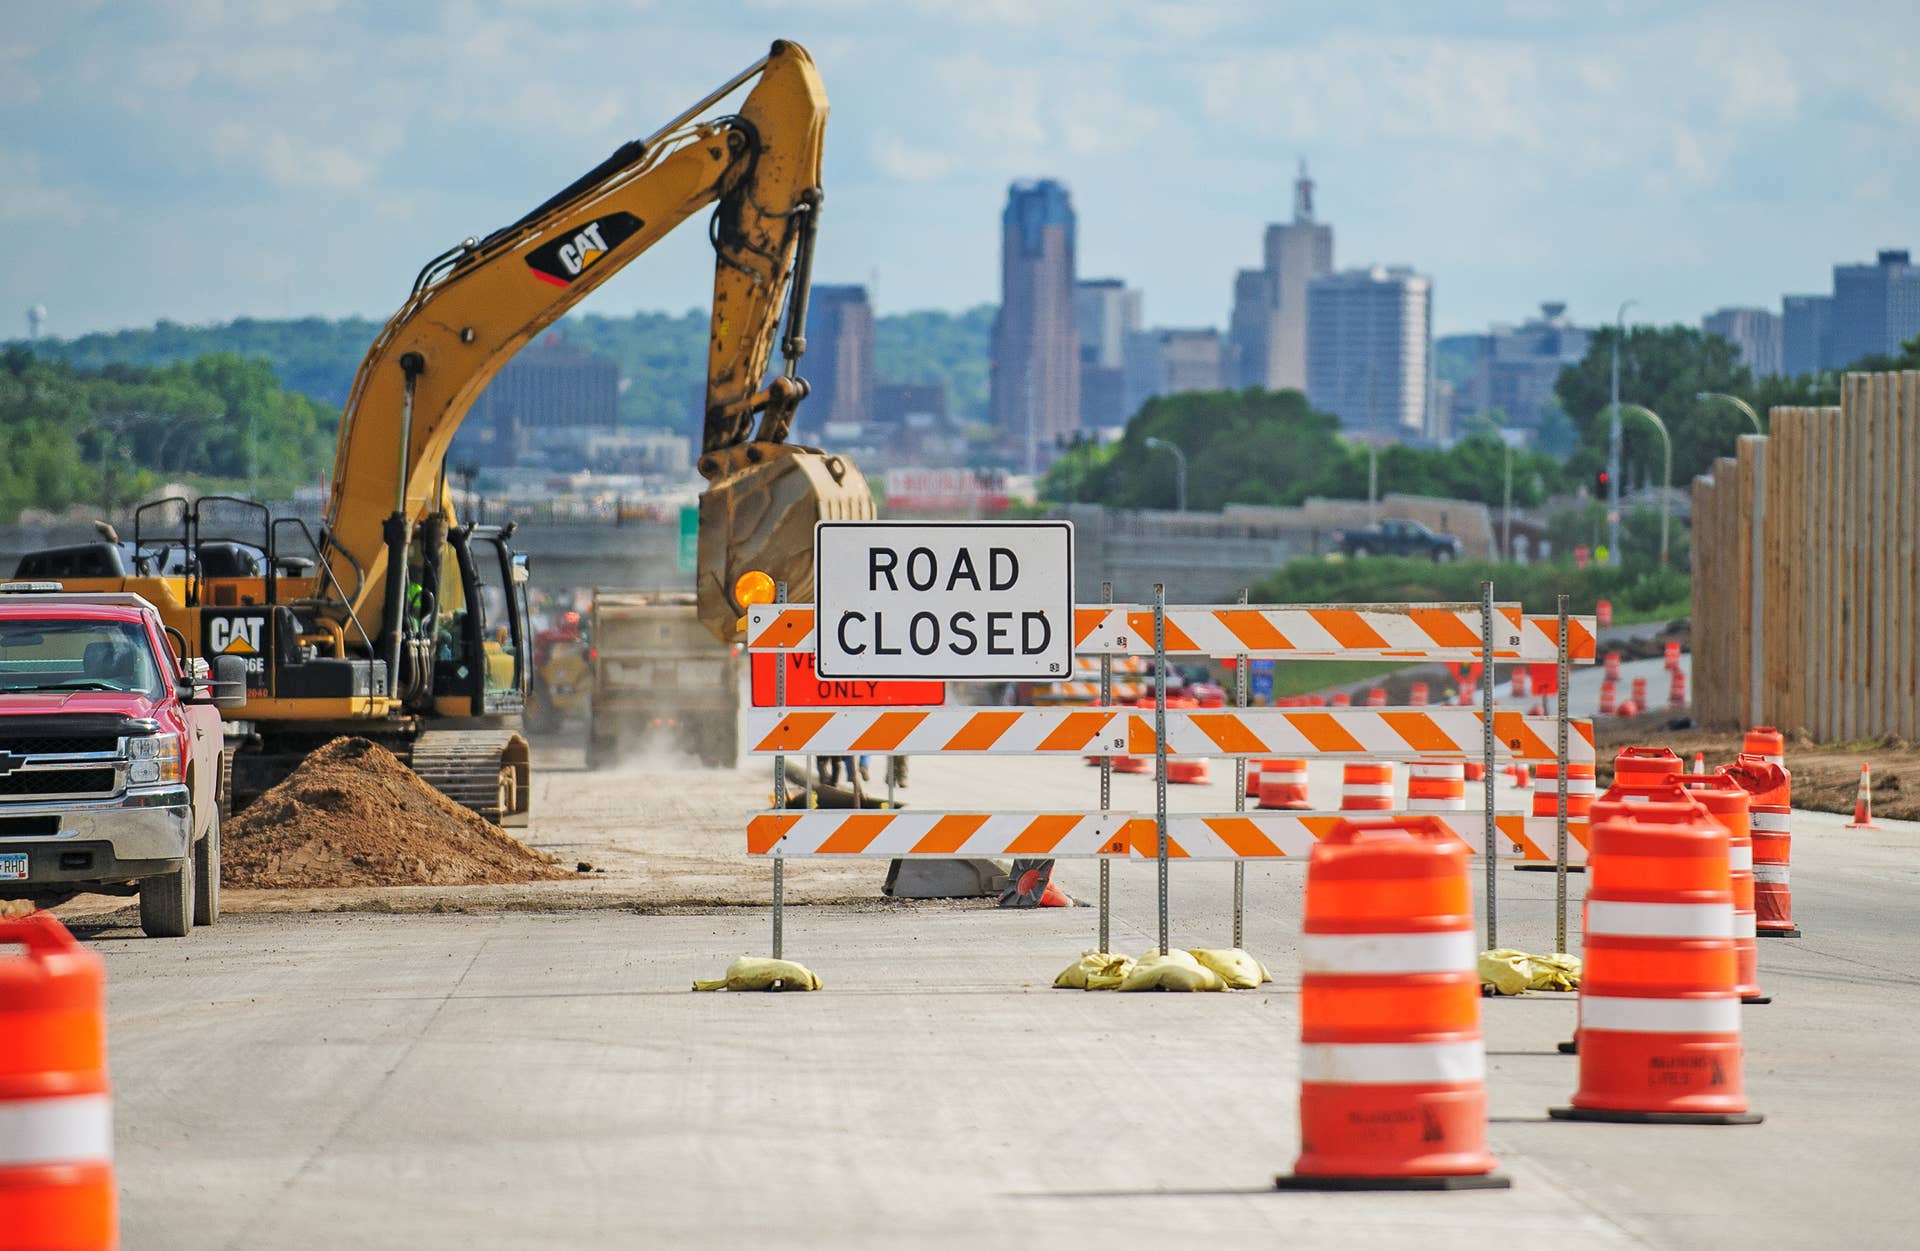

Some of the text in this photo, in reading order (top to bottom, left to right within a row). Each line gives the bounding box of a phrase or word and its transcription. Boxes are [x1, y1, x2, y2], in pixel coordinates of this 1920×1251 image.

[558, 221, 609, 275] CAT
[869, 547, 1019, 591] ROAD
[210, 616, 265, 653] CAT
[837, 611, 1051, 656] CLOSED
[817, 680, 878, 698] ONLY
